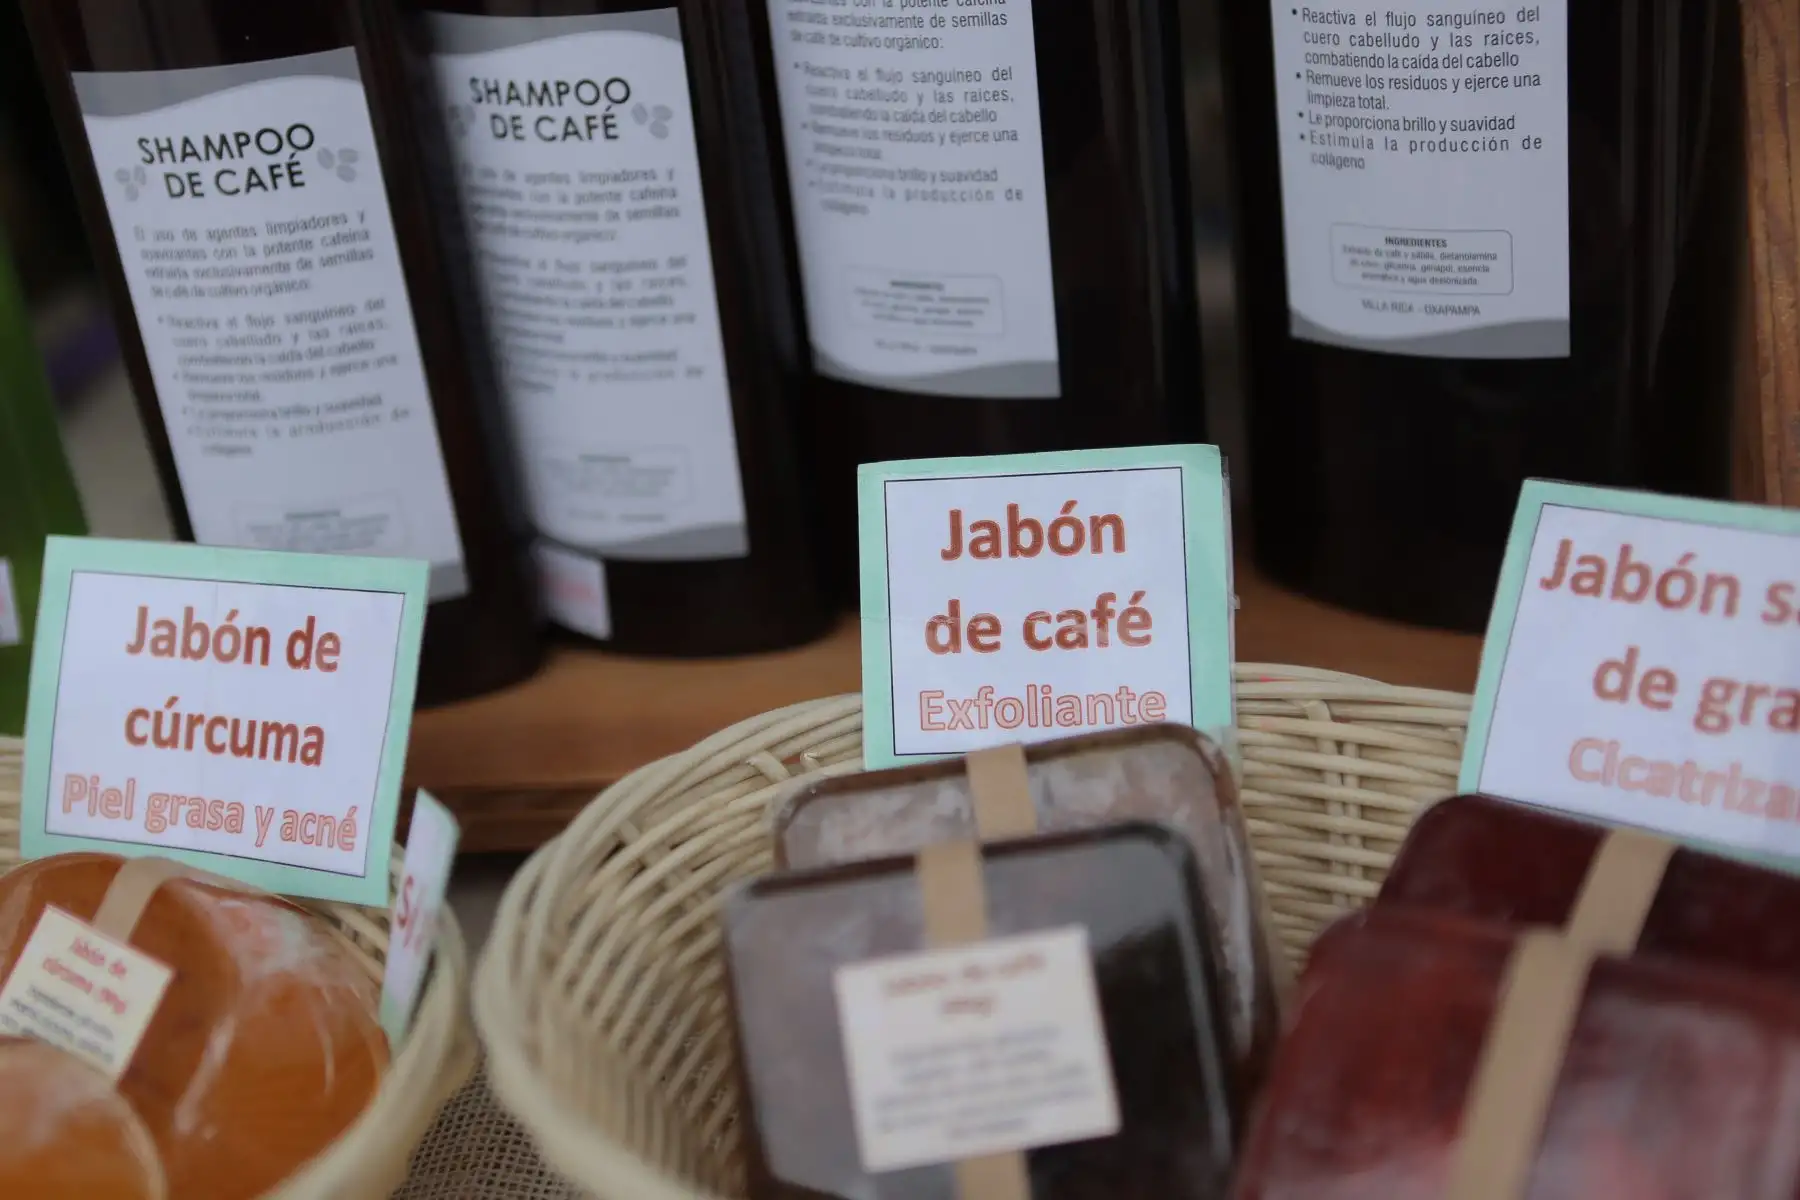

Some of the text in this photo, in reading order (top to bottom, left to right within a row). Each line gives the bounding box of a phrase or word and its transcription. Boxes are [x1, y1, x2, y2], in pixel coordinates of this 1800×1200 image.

[832, 14, 924, 29] exclusivamente
[930, 14, 945, 28] de
[951, 12, 1008, 28] semillas
[1302, 6, 1540, 30] Reactiva el flujo sanguíneo del
[843, 31, 882, 48] cultivo
[1304, 30, 1340, 46] cuero
[1349, 32, 1420, 48] cabelludo
[1430, 35, 1439, 51] y
[1450, 32, 1472, 48] las
[1305, 50, 1385, 69] combatiendo
[1388, 54, 1398, 69] la
[1442, 53, 1463, 69] del
[1466, 51, 1519, 68] cabello
[992, 65, 1012, 81] del
[1306, 69, 1541, 93] Remueve los residuos y ejerce una
[469, 76, 632, 107] SHAMPOO
[845, 87, 908, 103] cabelludo
[916, 90, 925, 106] y
[933, 89, 954, 103] las
[1308, 90, 1390, 110] limpieza total.
[489, 105, 620, 143] DE CAFÉ
[928, 108, 947, 123] del
[950, 107, 997, 123] cabello
[1308, 110, 1515, 135] Le proporciona brillo y suavidad
[137, 123, 315, 165] SHAMPOO
[882, 127, 935, 143] residuos
[938, 131, 946, 146] y
[949, 129, 989, 146] ejerce
[994, 128, 1018, 142] una
[1310, 131, 1542, 155] Estimula la producción de
[163, 153, 306, 199] DE CAFÉ
[930, 170, 937, 185] y
[940, 168, 998, 183] suavidad
[1005, 187, 1023, 201] de
[266, 212, 348, 236] limpiadores
[264, 238, 313, 257] potente
[1385, 236, 1447, 249] INGREDIENTES
[320, 248, 373, 266] semillas
[1361, 299, 1389, 312] VILLA
[1391, 301, 1414, 314] RICA
[1424, 303, 1481, 316] OXAPAMPA
[940, 499, 1126, 561] Jabón
[1539, 538, 1800, 626] Jabón s
[924, 590, 1153, 655] de café
[125, 605, 342, 673] Jabón de
[1593, 645, 1800, 735] de gra
[919, 683, 1167, 731] Exfoliante
[124, 696, 325, 767] cúrcuma
[1568, 737, 1800, 823] Cicatriza
[62, 774, 358, 852] Piel grasa y acné
